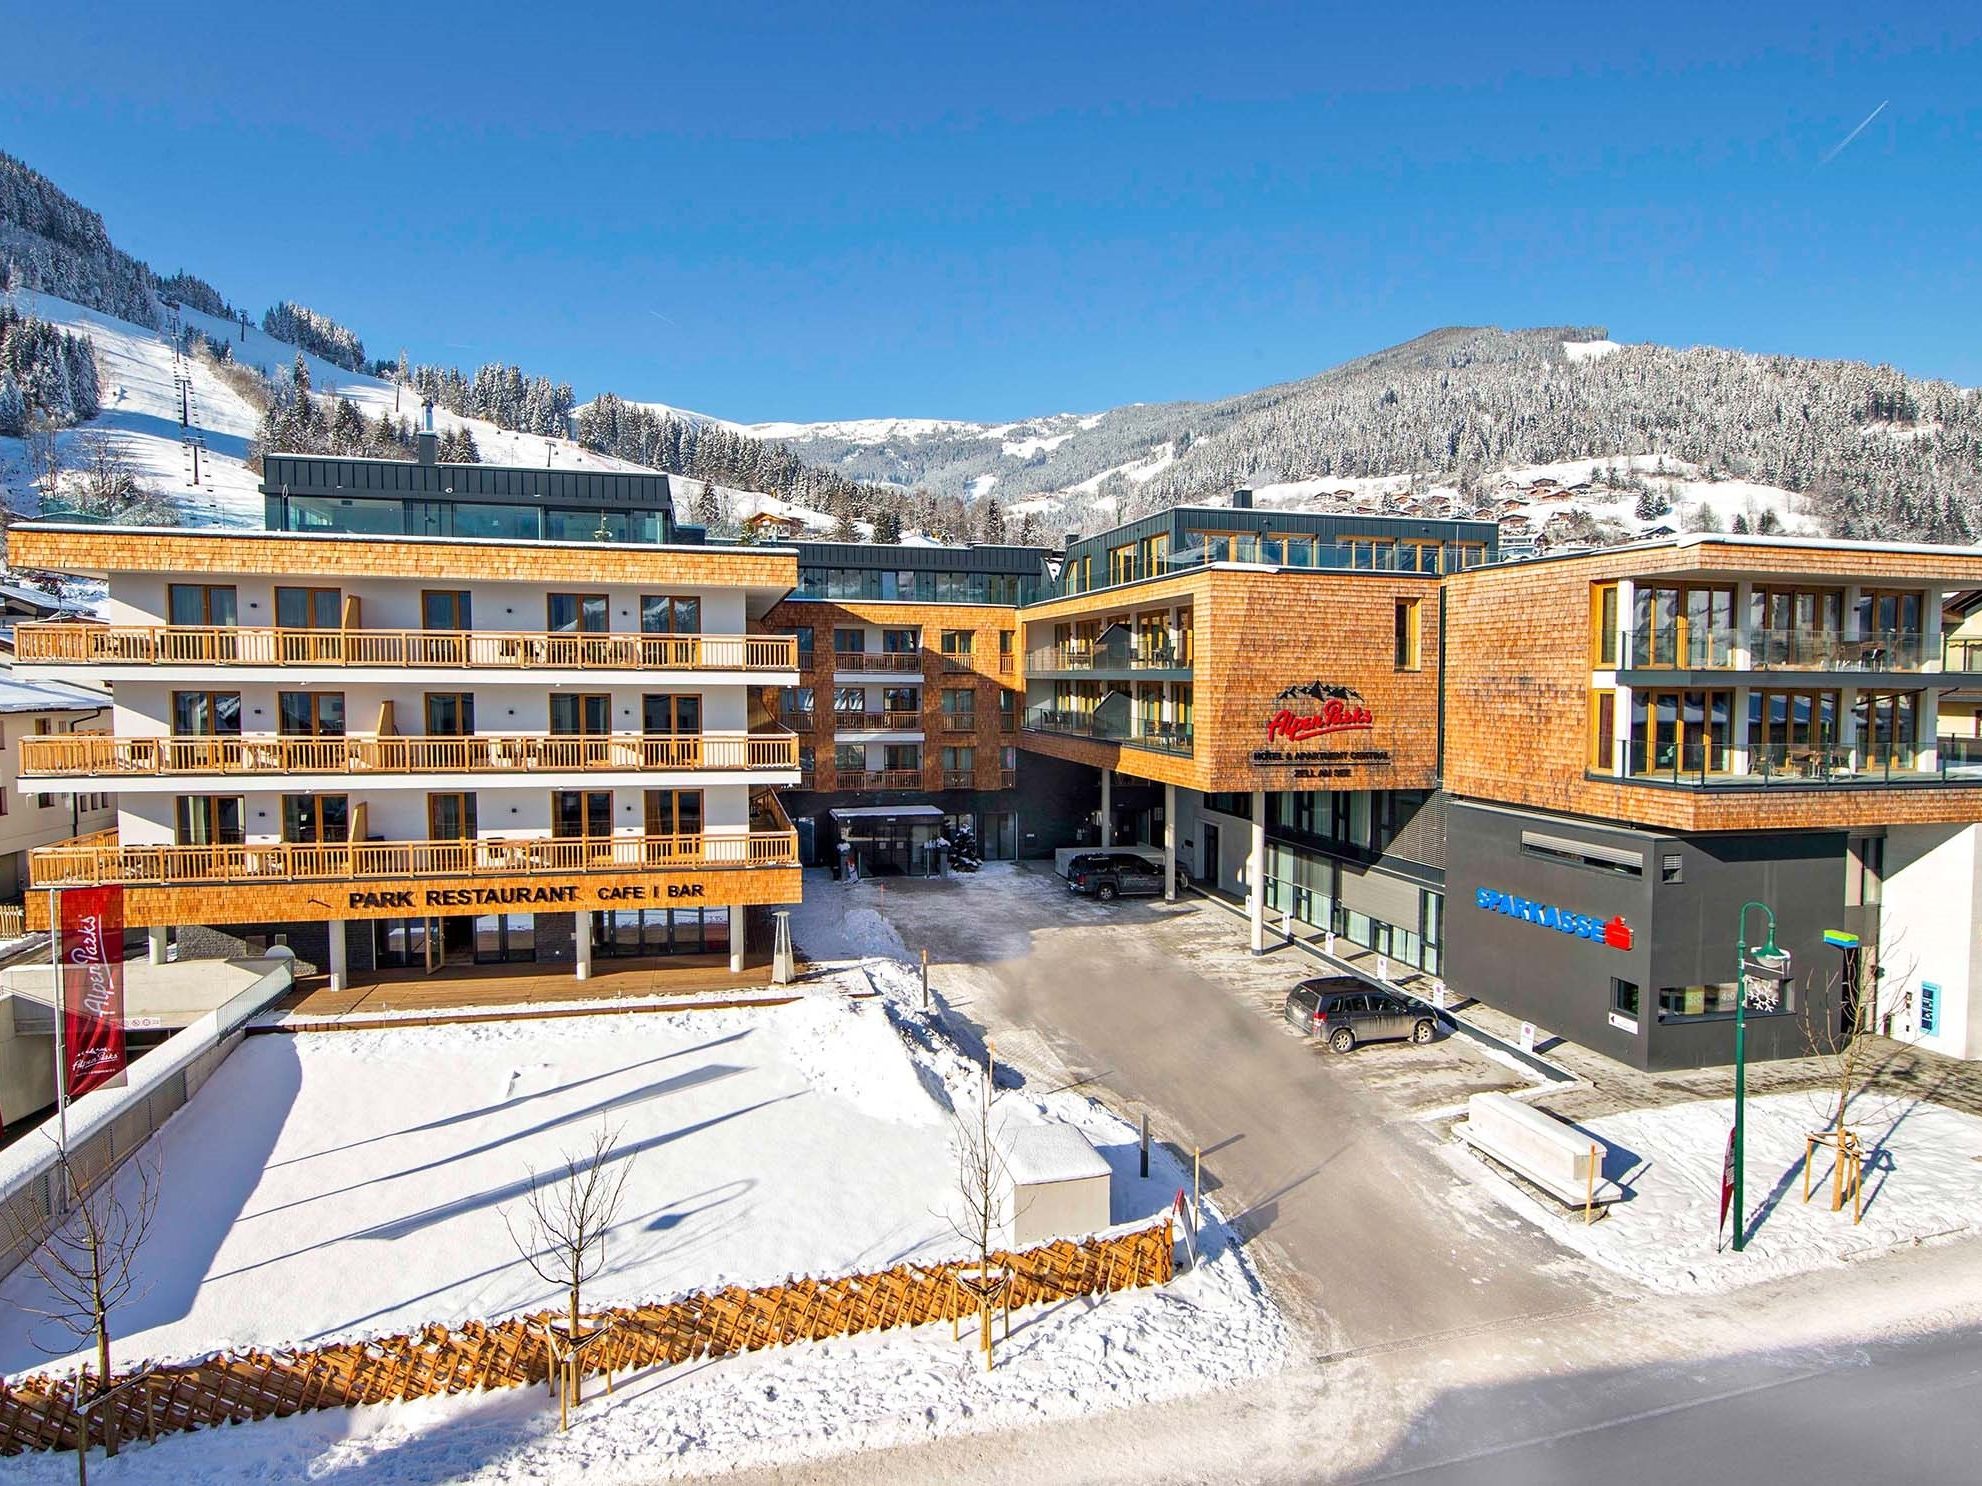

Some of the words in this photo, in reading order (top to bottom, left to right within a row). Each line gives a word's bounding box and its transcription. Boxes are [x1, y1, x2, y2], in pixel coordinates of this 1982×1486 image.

[1253, 751, 1284, 760] HOTEL
[1294, 751, 1349, 760] APARTMENT
[1350, 751, 1390, 760] CENTRAL
[1294, 769, 1316, 778] ZELL
[1317, 769, 1333, 777] AM
[1333, 769, 1351, 777] SEE
[348, 891, 415, 909] PARK
[425, 887, 579, 906] RESTAURANT
[597, 886, 646, 900] CAFE
[667, 884, 704, 898] BAR
[1475, 886, 1606, 944] SPARKASSE
